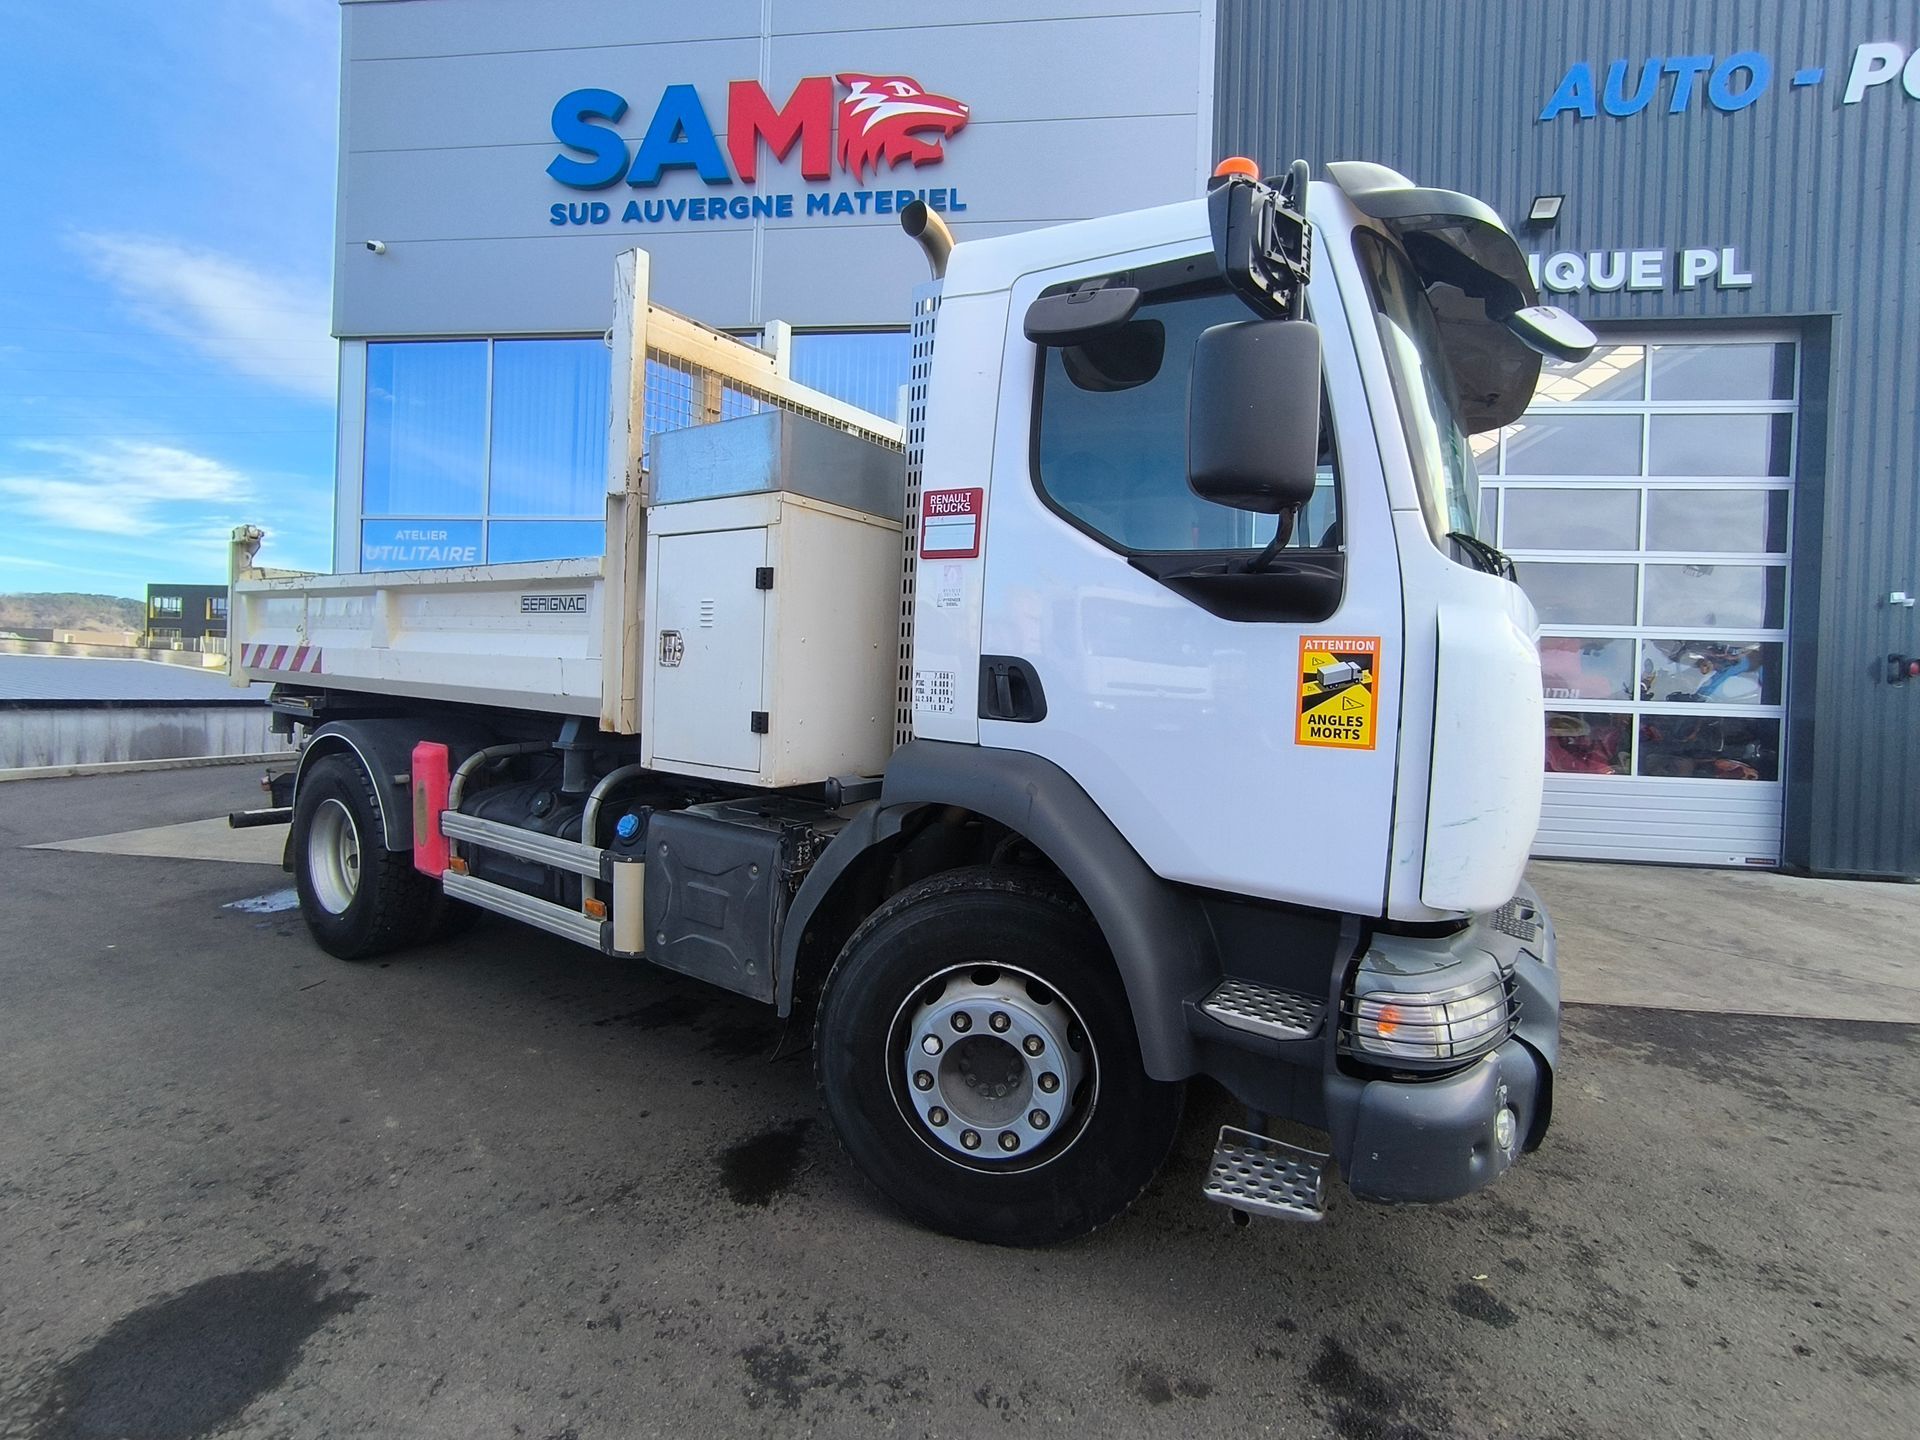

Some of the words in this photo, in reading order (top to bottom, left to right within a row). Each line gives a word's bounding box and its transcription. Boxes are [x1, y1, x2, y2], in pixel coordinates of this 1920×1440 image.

[1539, 51, 1772, 120] AUTO
[546, 76, 832, 191] SAM
[549, 201, 611, 226] SUD
[621, 194, 794, 224] AUVERGNE
[806, 188, 968, 216] MATERIEL
[1681, 247, 1753, 289] PL
[930, 492, 972, 505] RENAULT
[930, 502, 971, 514] TRUCKS
[395, 530, 448, 541] ATELIER
[366, 545, 477, 561] UTILITAIRE
[522, 597, 585, 611] SERIGNAC
[1304, 640, 1375, 651] ATTENTION
[1307, 714, 1364, 728] ANGLES
[1310, 727, 1360, 740] MORTS
